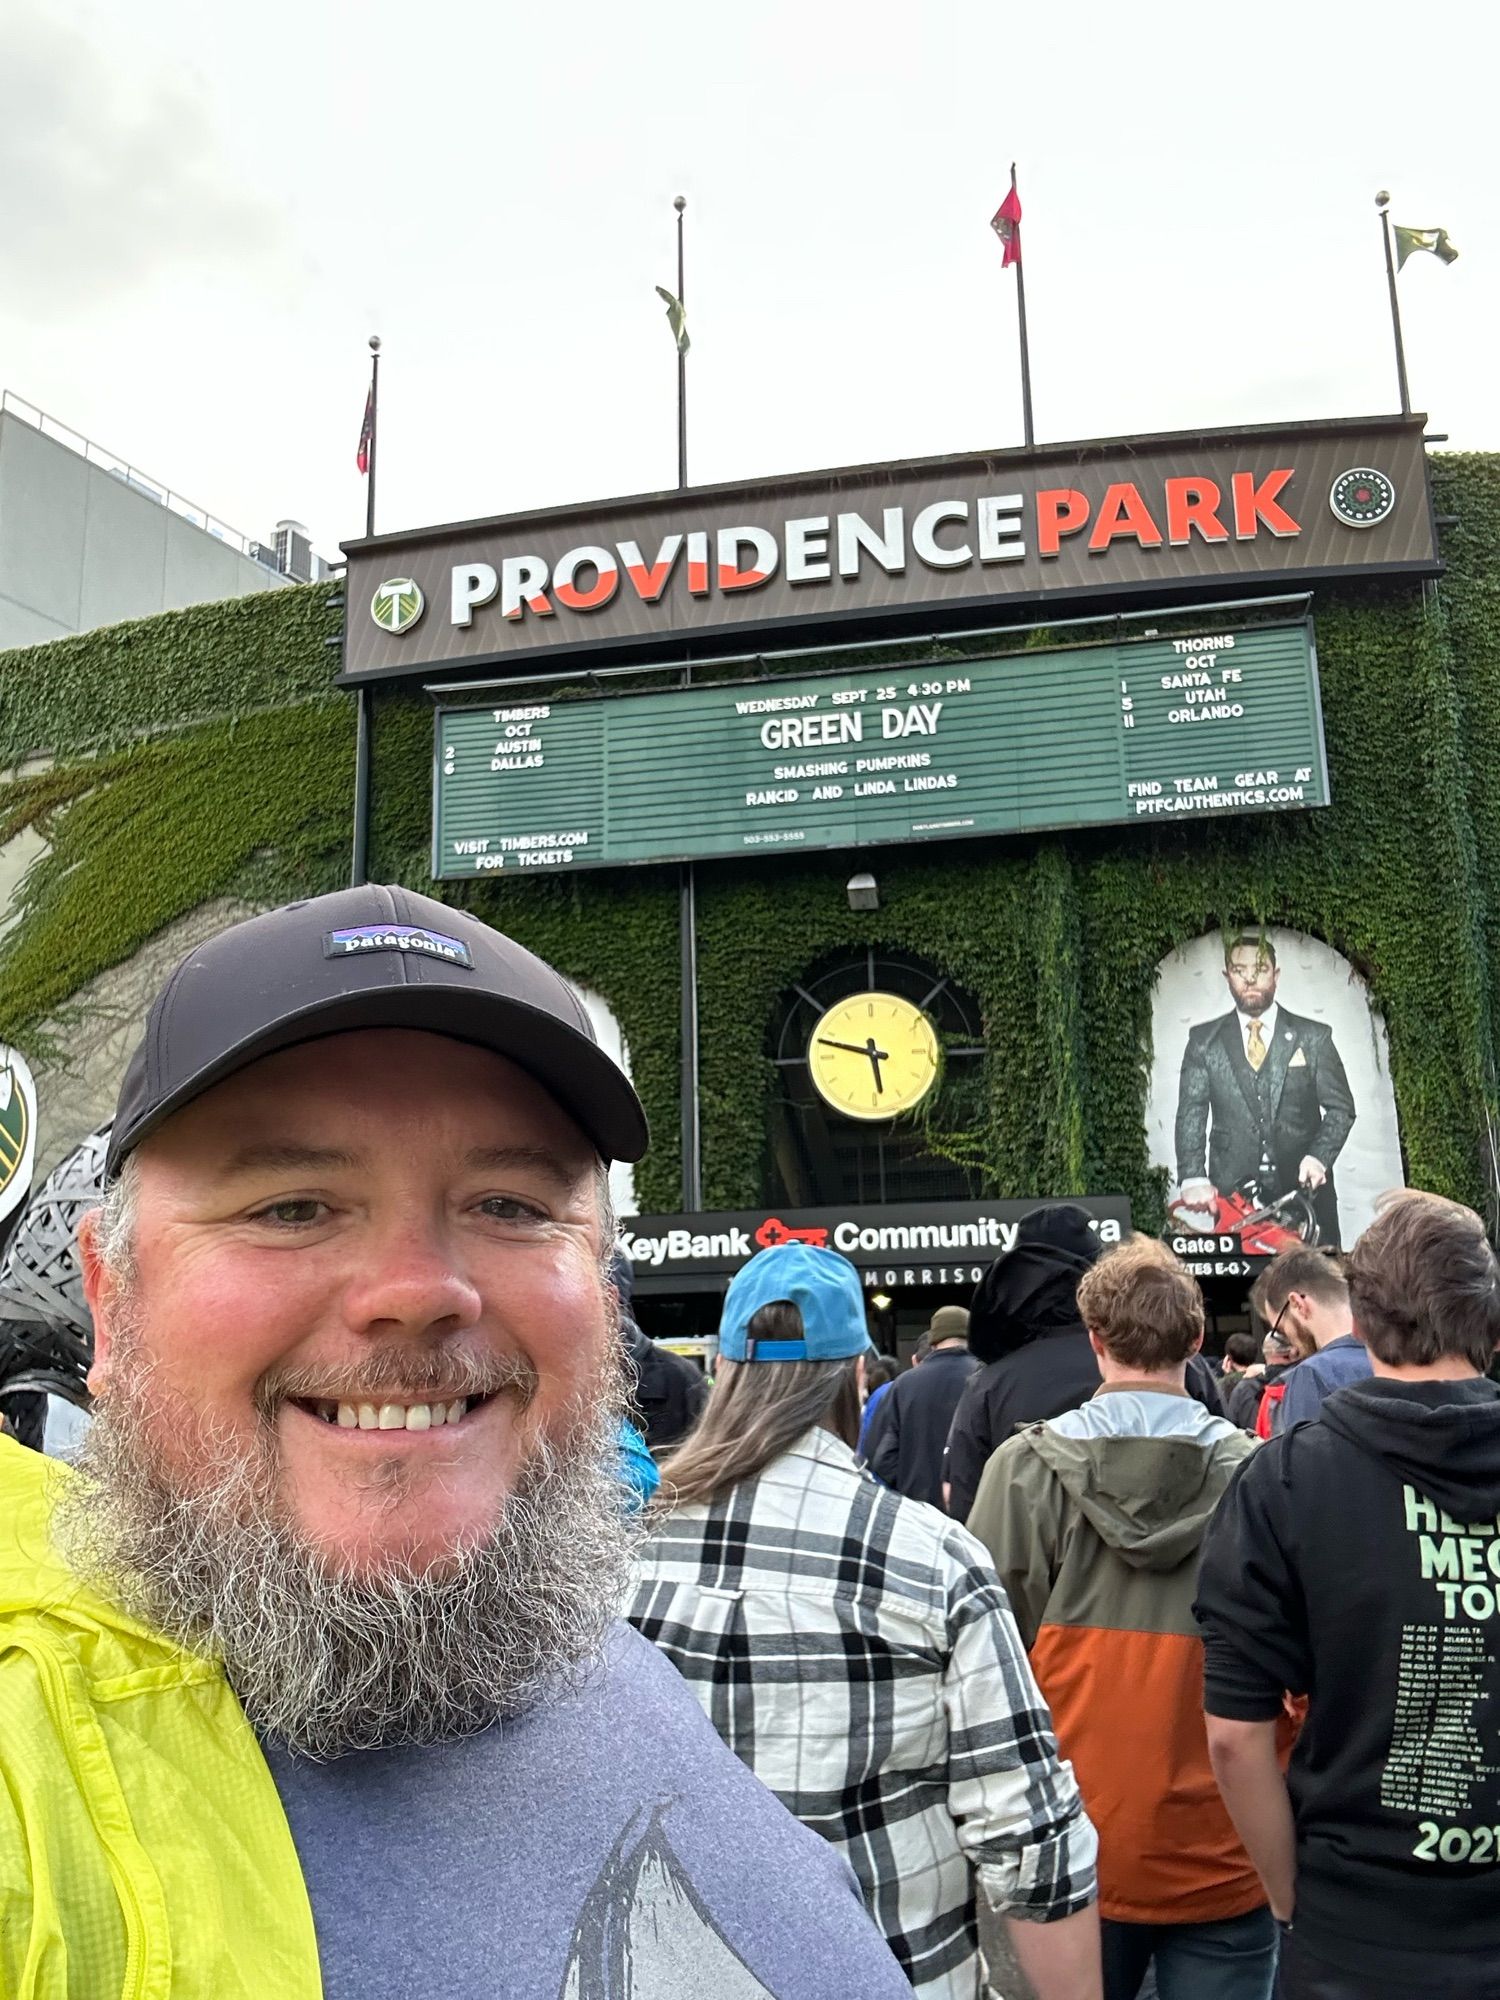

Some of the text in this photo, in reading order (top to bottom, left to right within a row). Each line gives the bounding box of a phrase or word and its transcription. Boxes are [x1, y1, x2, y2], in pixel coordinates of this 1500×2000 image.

[1172, 635, 1235, 654] THORNS
[1185, 654, 1217, 669] OCT
[1161, 672, 1212, 689] SANTA
[1222, 669, 1242, 683] FE
[736, 695, 819, 714] WEDNESDAY
[832, 689, 868, 705] SEPT
[876, 686, 896, 700] 25
[946, 678, 971, 693] PM
[1121, 687, 1227, 711] 5 UTAH
[493, 706, 551, 723] TIMBERS
[1168, 703, 1244, 723] ORLANDO
[505, 724, 533, 737] OCT
[760, 702, 943, 750] GREEN DAY
[445, 739, 541, 759] 2 AUSTIN
[444, 755, 545, 775] 6 DALLAS
[774, 753, 932, 780] SMASHING PUMPKINS
[746, 774, 958, 806] RANCID AND LINDA LINDAS
[1128, 767, 1312, 797] FIND TEAM GEAR AT
[1136, 786, 1304, 814] PTFCAUTHENTICS.COM
[454, 832, 588, 855] VISIT TIMBERS.COM
[476, 850, 574, 870] FOR TICKETS
[345, 934, 456, 958] patagonia
[616, 1217, 1018, 1266] KeyBank Community
[1172, 1237, 1215, 1253] Gate
[1220, 1236, 1234, 1253] D
[865, 1267, 983, 1286] MORRISO
[1436, 1582, 1500, 1620] TO
[1412, 1821, 1500, 1863] 2021
